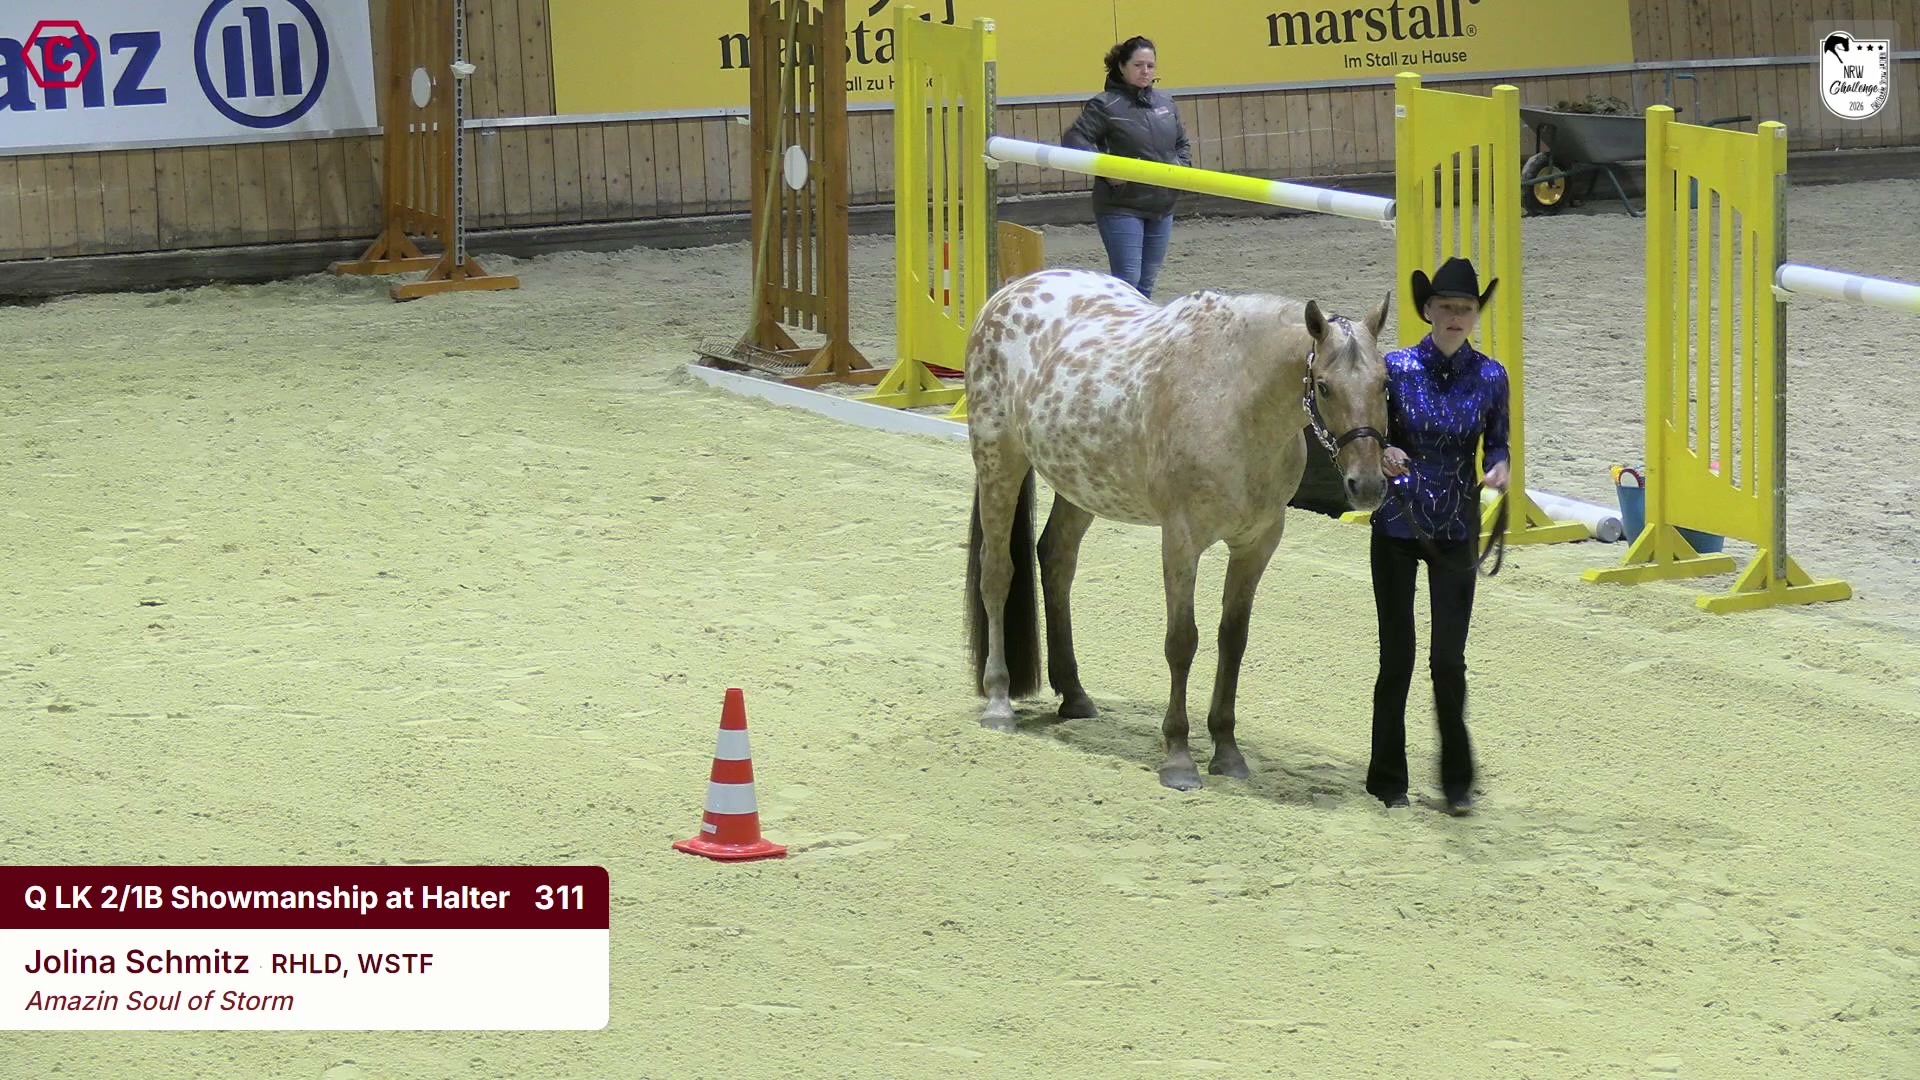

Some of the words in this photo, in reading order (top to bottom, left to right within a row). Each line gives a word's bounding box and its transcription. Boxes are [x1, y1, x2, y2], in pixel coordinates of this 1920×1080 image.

[1344, 54, 1362, 69] Im
[1366, 52, 1398, 68] Stall
[1401, 53, 1418, 66] zu
[1422, 50, 1468, 64] Hause
[866, 79, 885, 91] zu
